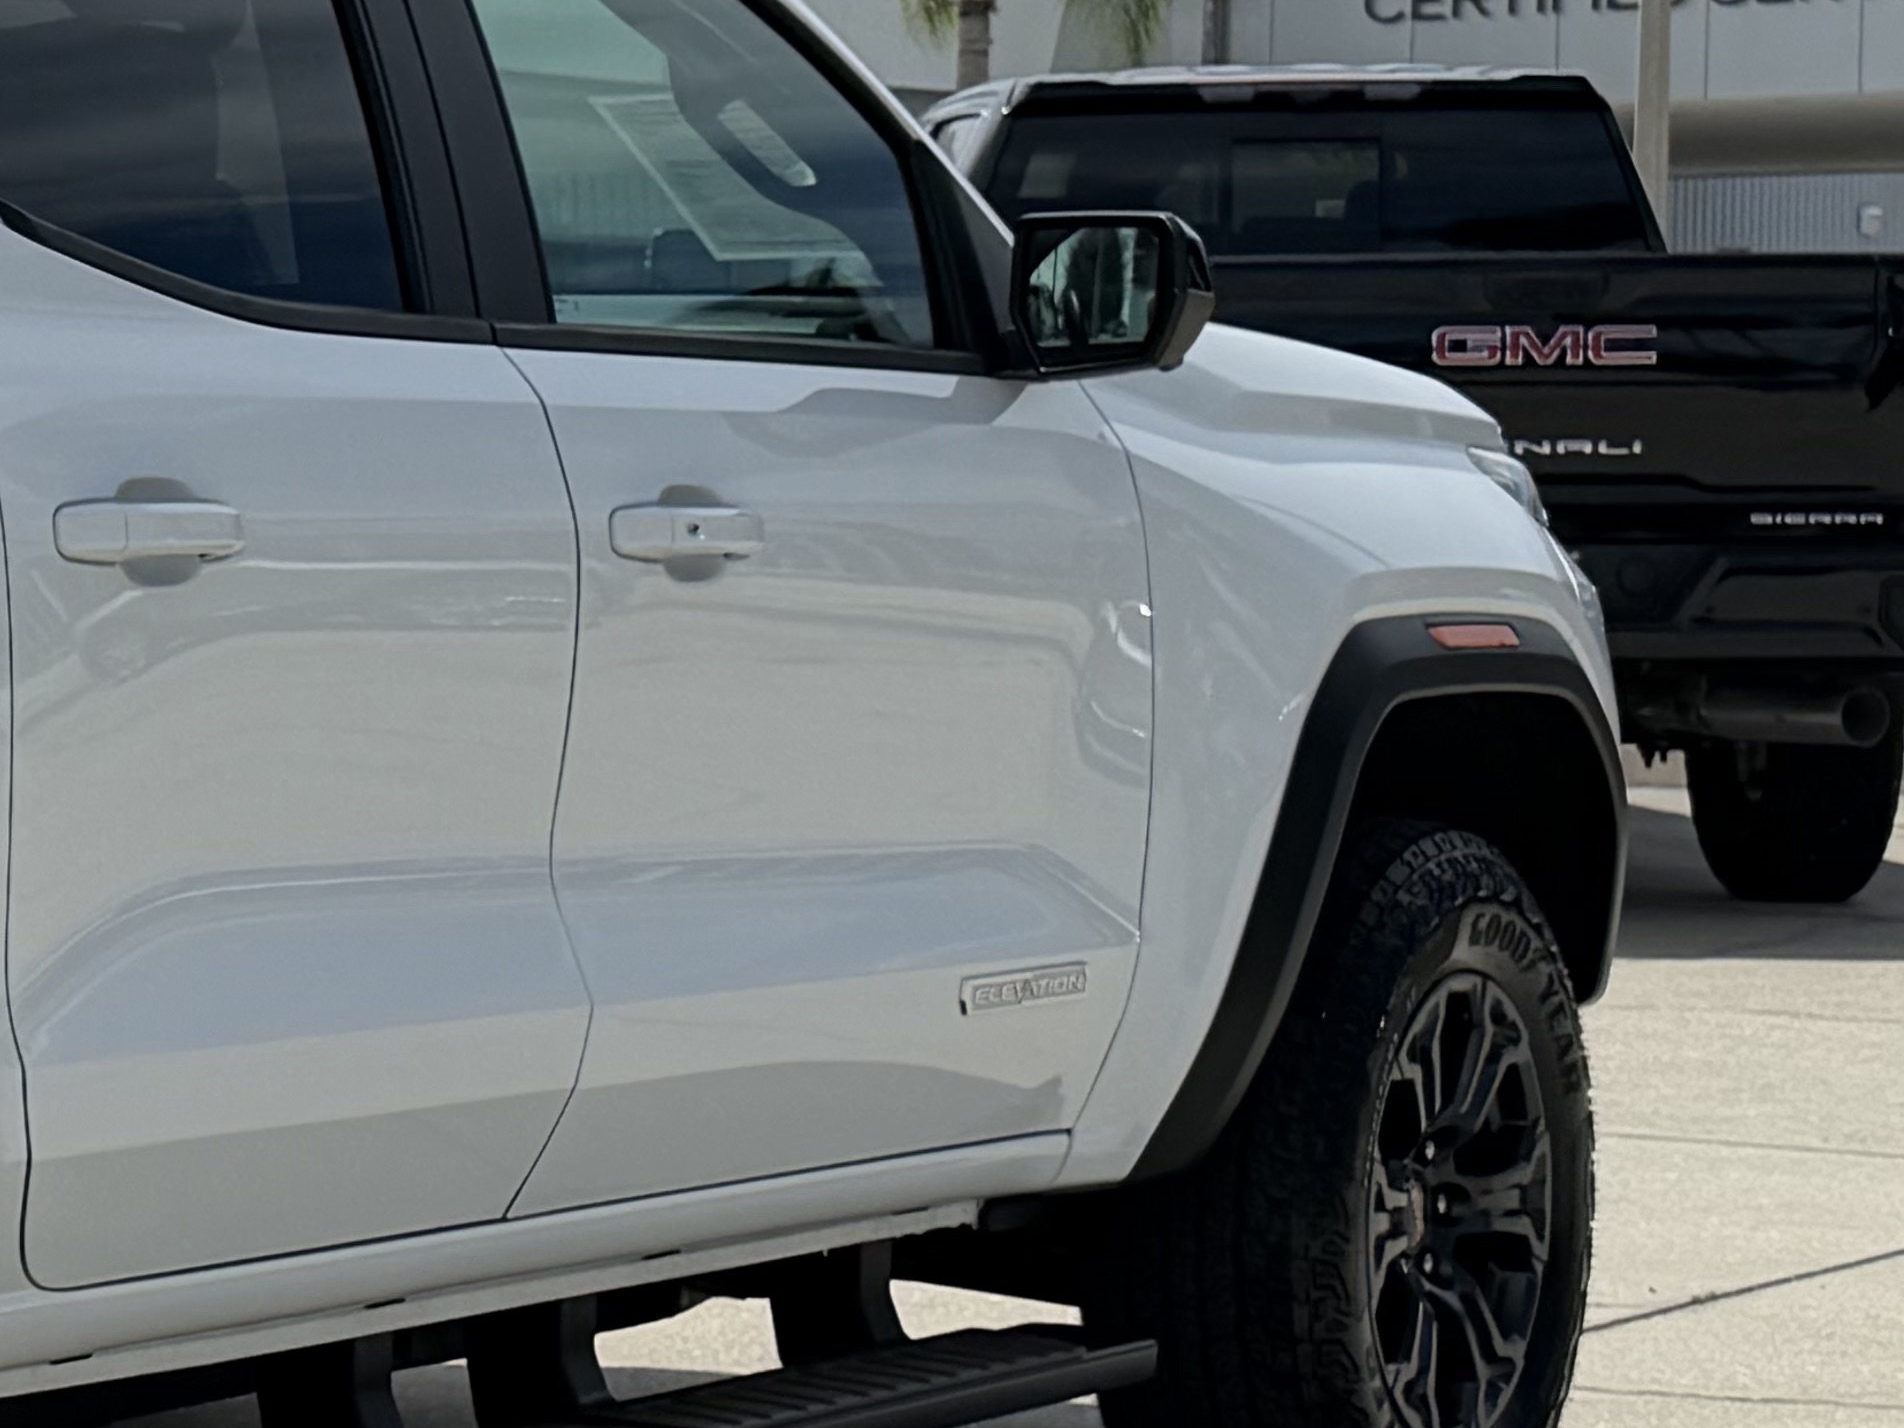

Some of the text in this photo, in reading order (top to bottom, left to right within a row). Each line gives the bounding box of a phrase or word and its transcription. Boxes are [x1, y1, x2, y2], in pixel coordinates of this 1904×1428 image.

[1431, 324, 1658, 367] GMC
[1513, 438, 1643, 455] NALI
[1749, 512, 1884, 526] SIERRA
[974, 972, 1086, 1005] ELEVATION
